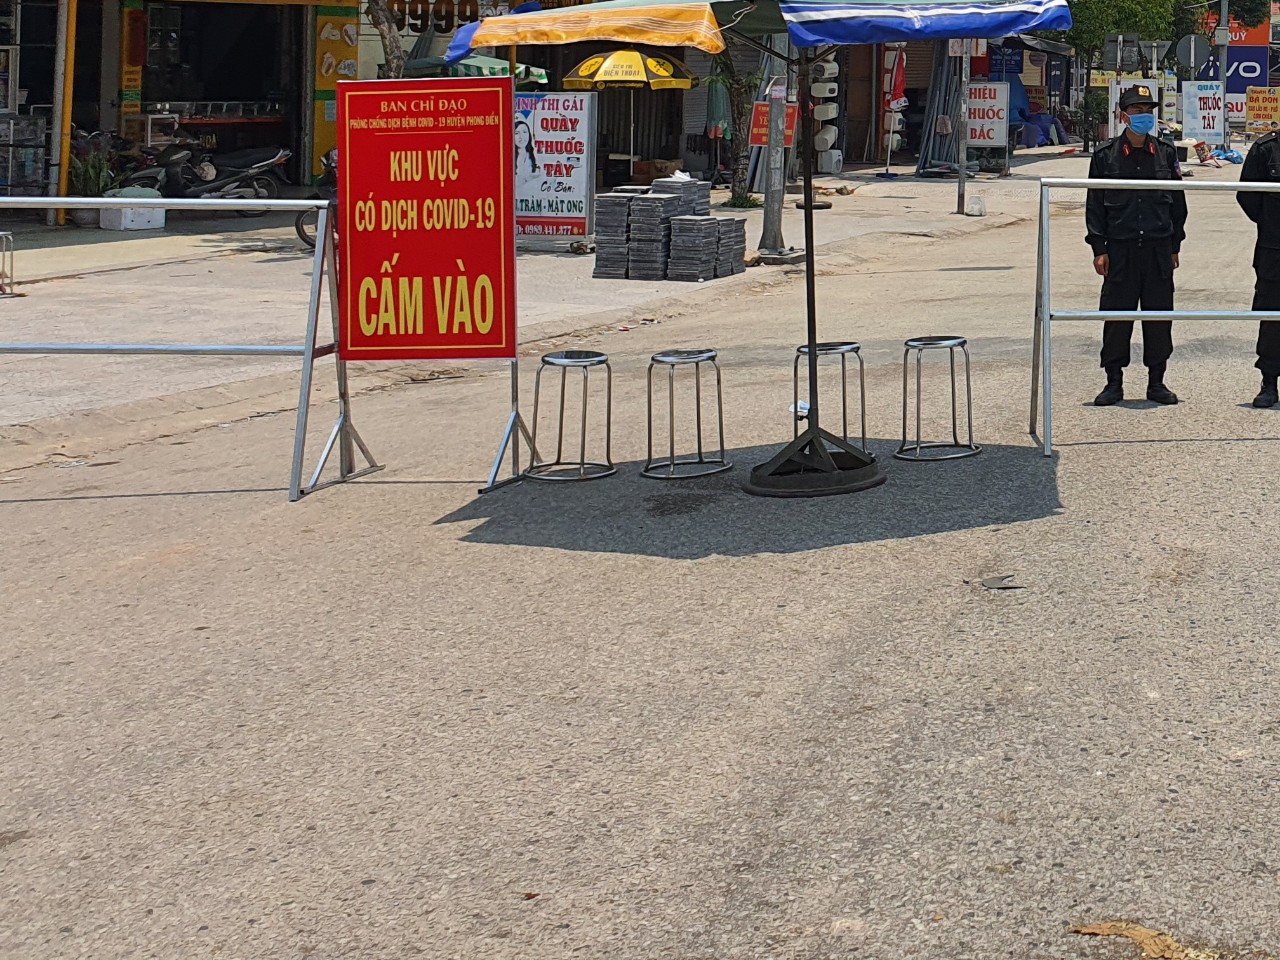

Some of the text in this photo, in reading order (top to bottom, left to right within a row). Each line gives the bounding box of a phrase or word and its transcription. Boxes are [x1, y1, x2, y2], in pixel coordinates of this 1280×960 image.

[969, 86, 997, 102] HIỆU
[1198, 93, 1222, 111] THUỐC
[380, 96, 467, 114] BAN CHỈ ĐẠO
[541, 96, 584, 115] THỊ GÁI
[968, 105, 1005, 120] HUỐC
[350, 117, 368, 130] PHÒNG
[369, 115, 387, 129] CHỐNG
[388, 118, 401, 130] DỊCH
[418, 117, 434, 128] COVID
[439, 117, 446, 127] 19
[466, 115, 485, 127] PHONG
[1202, 113, 1216, 130] TÂY
[970, 124, 995, 140] BẮC
[535, 137, 584, 155] THUỐC
[390, 143, 459, 187] KHU VỰC
[544, 160, 574, 178] TÂY
[541, 181, 552, 193] Có
[355, 192, 495, 238] CÓ DỊCH COVID-19
[520, 196, 583, 216] TRÀM MẬT ONG
[358, 253, 494, 337] CẤM VÀO
